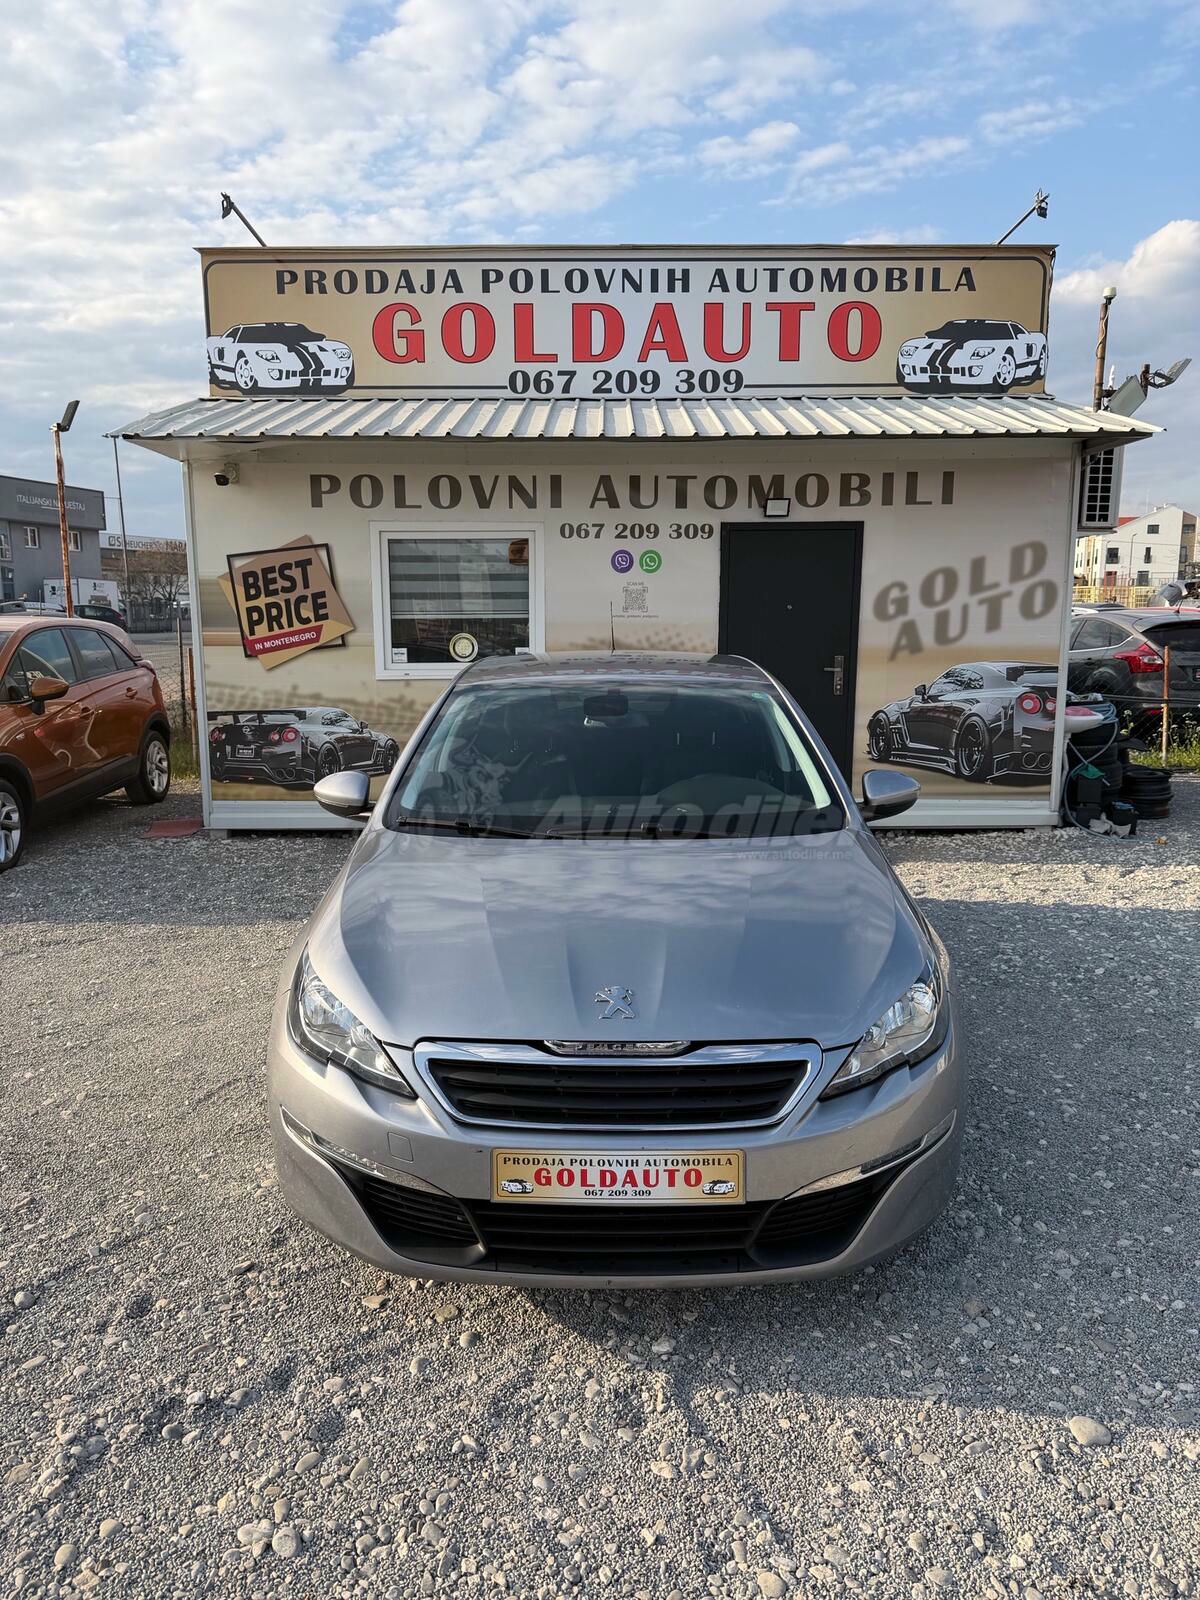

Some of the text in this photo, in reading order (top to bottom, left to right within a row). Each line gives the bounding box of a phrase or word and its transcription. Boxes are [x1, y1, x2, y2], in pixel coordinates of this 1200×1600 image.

[275, 266, 977, 295] PRODAJA POLOVNIH AUTOMOBILA
[371, 301, 882, 364] GOLDAUTO
[508, 369, 745, 395] 067 209 309
[309, 471, 956, 510] POLOVNI AUTOMOBILI
[559, 522, 715, 540] 067 209 309
[241, 558, 313, 602] BEST
[872, 540, 1048, 622] GOLD
[245, 591, 329, 636] PRICE
[887, 578, 1059, 663] AUTO
[255, 631, 317, 651] IN MONTENEGRO
[503, 1156, 733, 1167] PRODAJA POLOVNIH AUTOMOBILA
[534, 1167, 703, 1188] GOLDAUTO
[584, 1189, 652, 1197] 067 209 309
